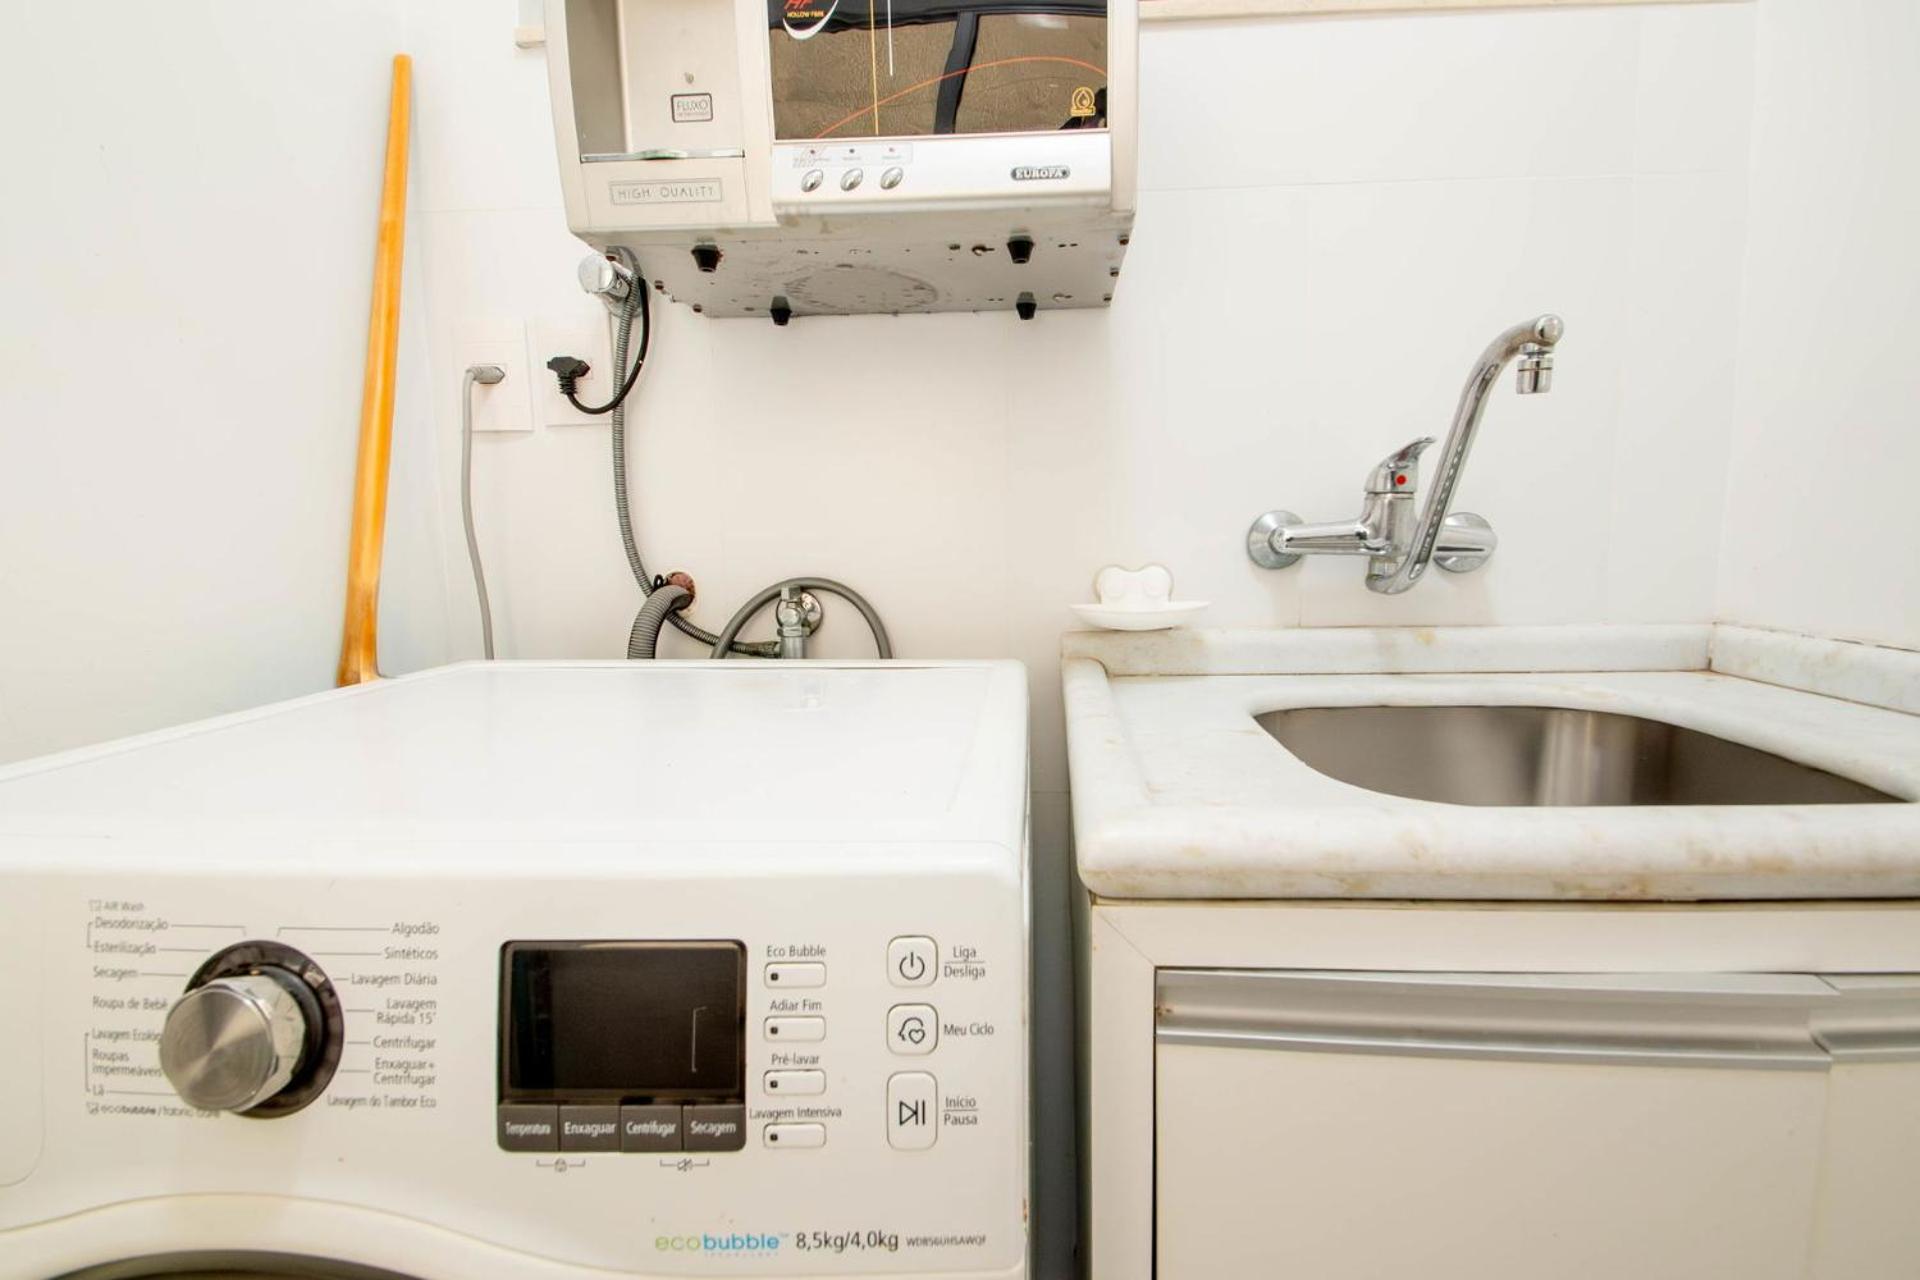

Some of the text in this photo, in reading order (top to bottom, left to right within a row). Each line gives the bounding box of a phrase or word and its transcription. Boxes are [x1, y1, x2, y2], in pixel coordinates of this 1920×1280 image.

[1014, 168, 1065, 179] EUROPA
[618, 185, 714, 200] HIGH QUALITY
[94, 917, 169, 932] Desodorização
[391, 922, 440, 938] Algodão
[94, 940, 157, 957] Esterilização
[383, 947, 439, 960] Sintéticos
[766, 945, 827, 957] Eco Bubble
[952, 946, 977, 962] Liga
[93, 966, 139, 981] Secagem
[351, 973, 438, 988] Lavagem Diária
[944, 965, 986, 981] Desliga
[92, 995, 124, 1010] Roupa
[126, 997, 140, 1009] de
[386, 998, 437, 1013] Lavagem
[770, 1000, 822, 1011] Adiar Fim
[376, 1012, 416, 1026] Rápida
[91, 1027, 131, 1043] Lavagem
[944, 1022, 995, 1036] Meu Ciclo
[372, 1035, 437, 1052] Centrifugar
[92, 1048, 130, 1063] Roupas
[771, 1053, 820, 1066] Pré-lavar
[373, 1072, 437, 1089] Centrifugar
[327, 1094, 438, 1112] Lavagem do Tambor Eco
[945, 1095, 977, 1109] Início
[749, 1106, 843, 1122] Lavagem Intensiva
[944, 1112, 979, 1126] Pausa
[505, 1119, 552, 1137] Temperatura
[564, 1120, 616, 1138] Enxaguar
[626, 1120, 677, 1138] Centrifugar
[690, 1119, 737, 1137] Secagem
[795, 1230, 899, 1253] 8,5kg/4,0kg
